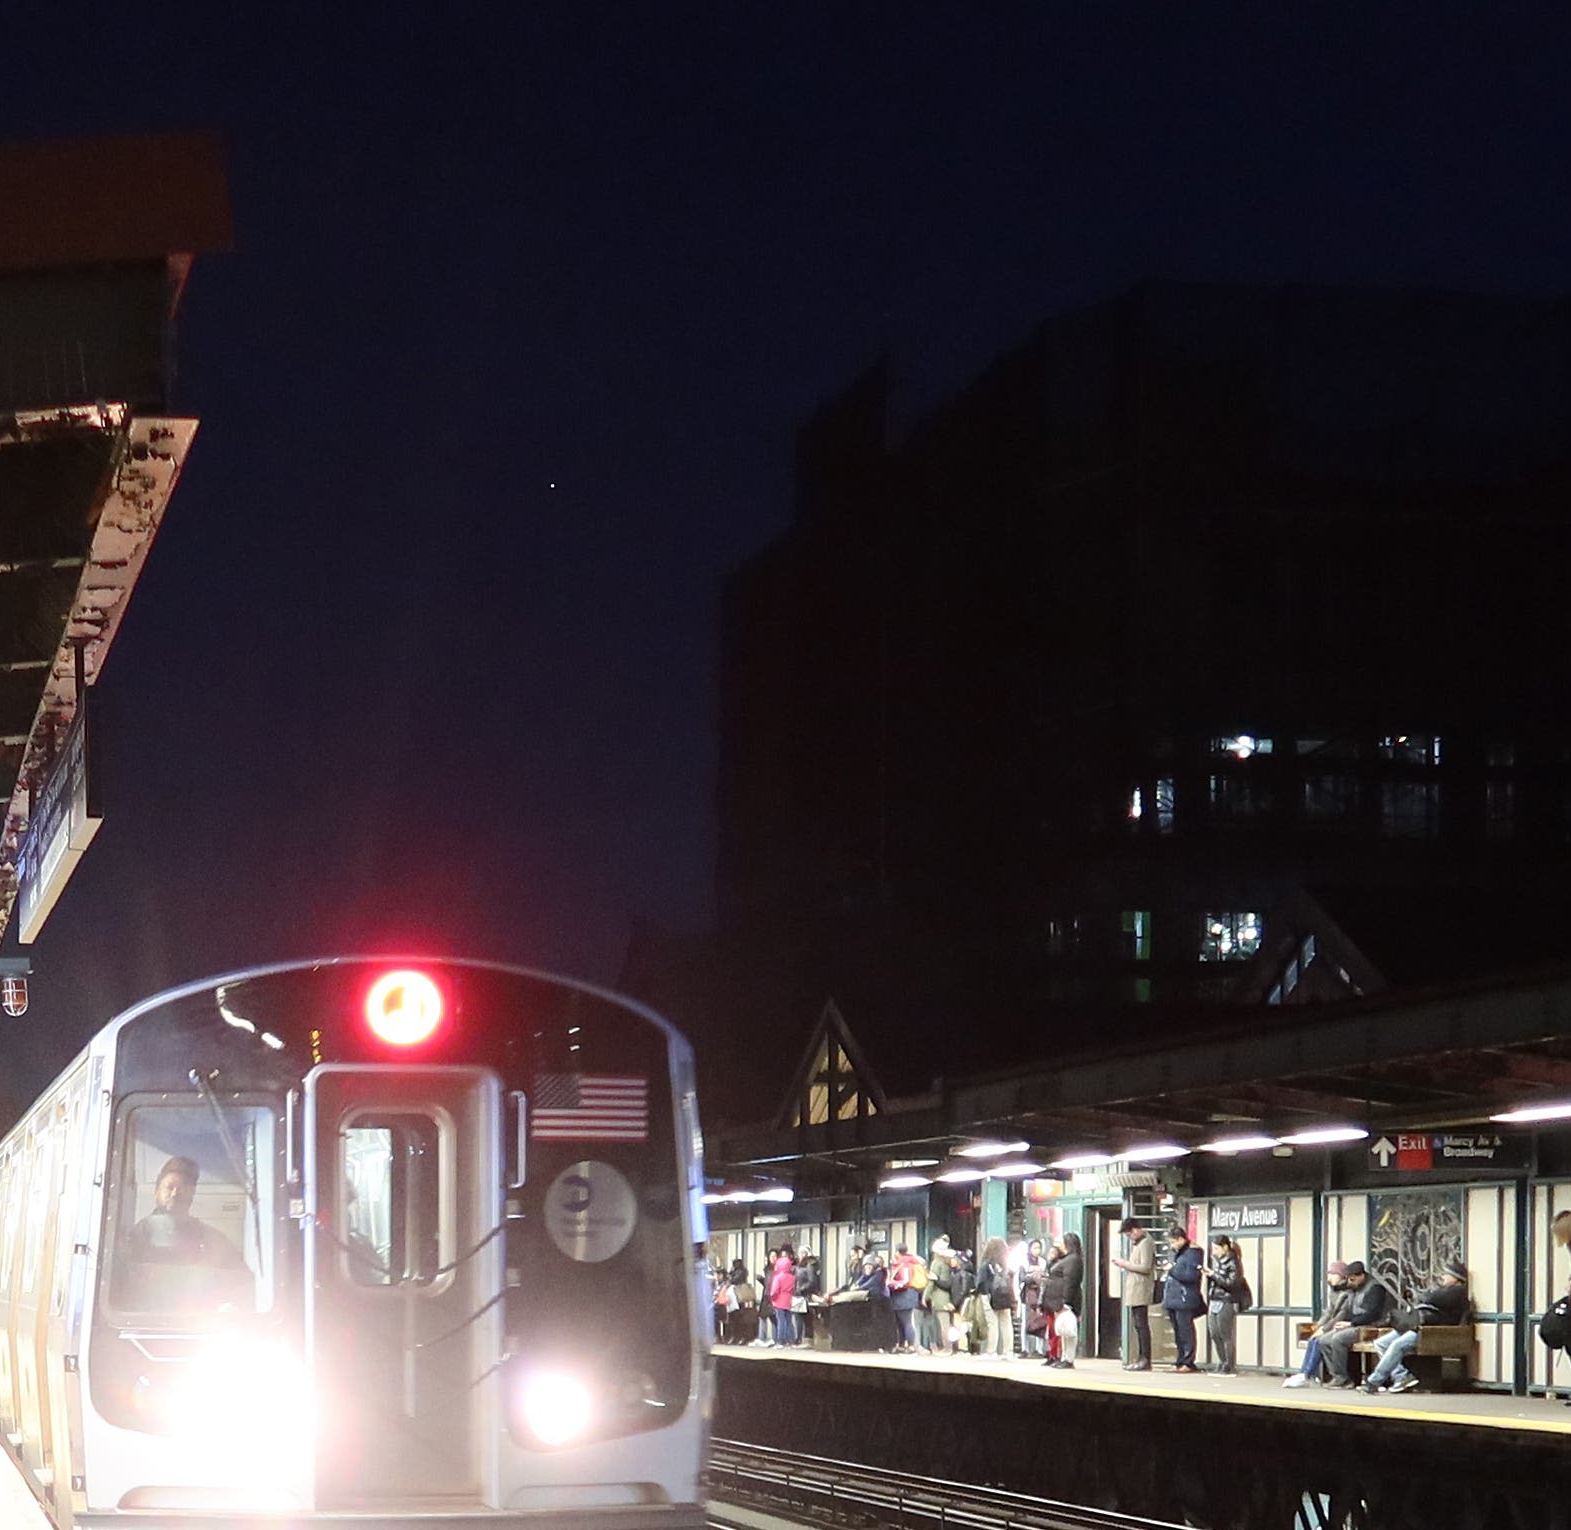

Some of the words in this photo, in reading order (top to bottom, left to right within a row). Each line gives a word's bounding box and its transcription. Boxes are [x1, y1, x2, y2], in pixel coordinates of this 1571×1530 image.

[1398, 1135, 1427, 1150] Exit
[1443, 1135, 1474, 1148] Marcy
[1443, 1146, 1495, 1159] Broadway
[1212, 1206, 1241, 1231] Marcy
[1241, 1205, 1278, 1227] Avenue
